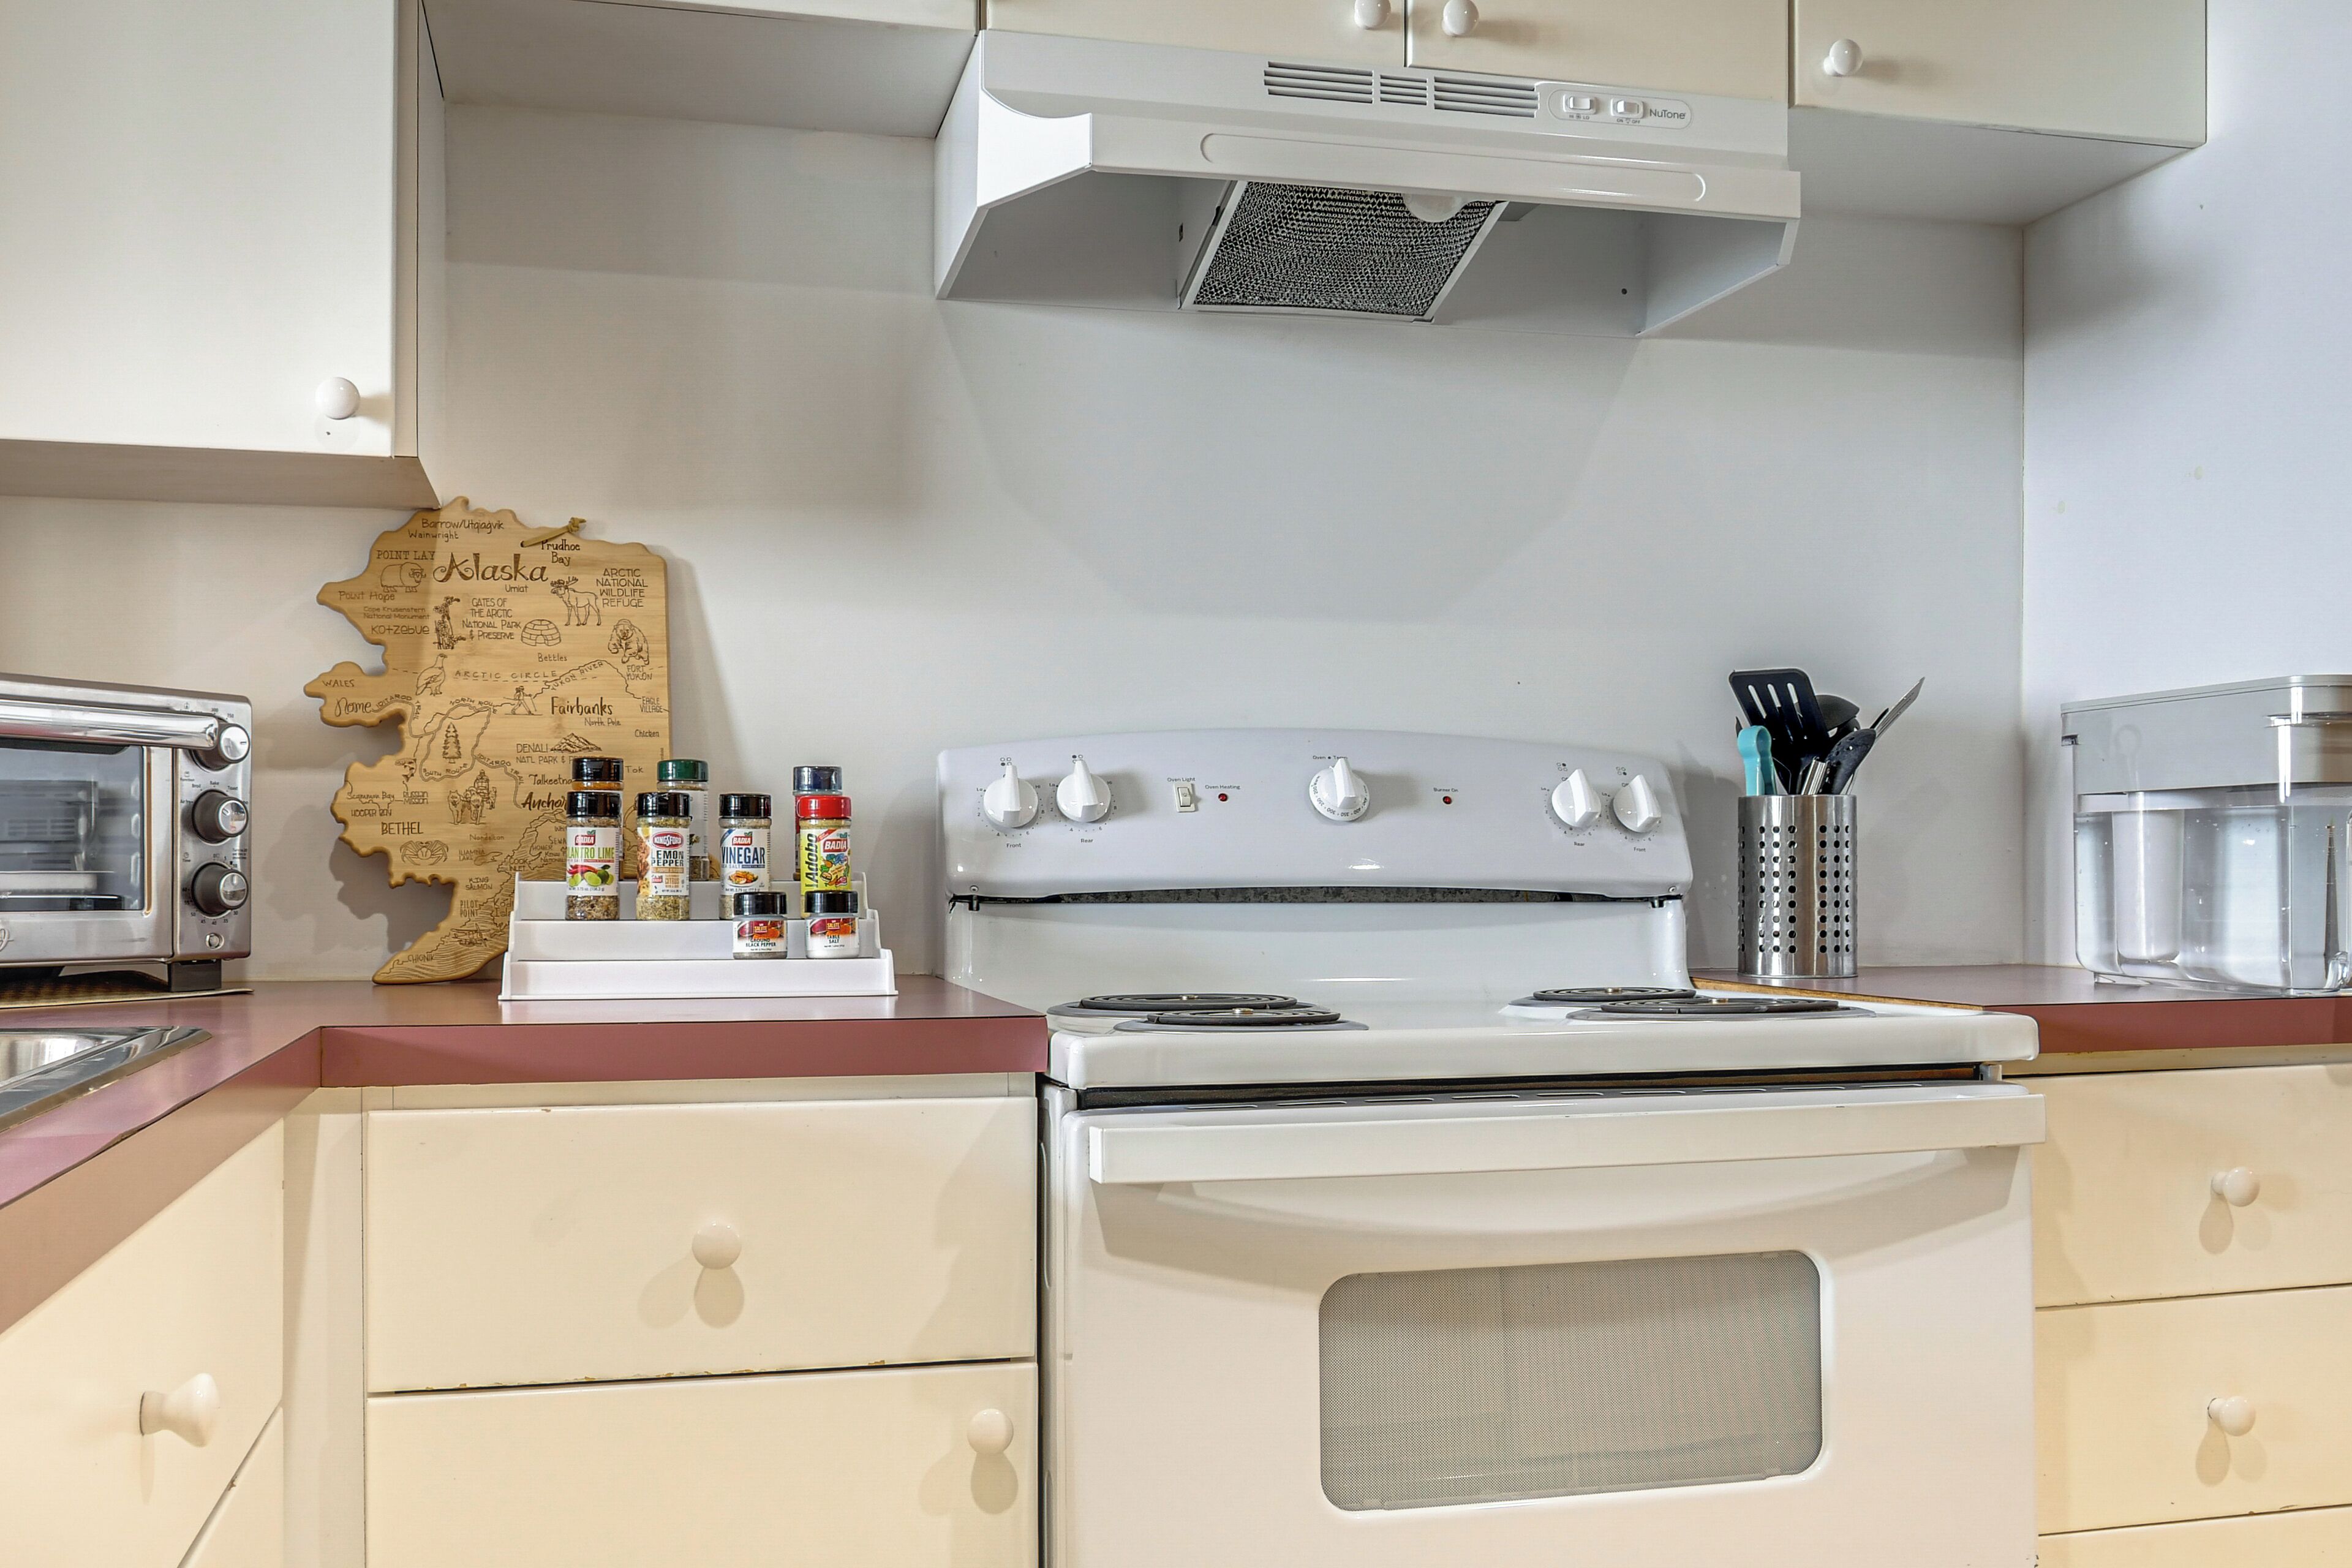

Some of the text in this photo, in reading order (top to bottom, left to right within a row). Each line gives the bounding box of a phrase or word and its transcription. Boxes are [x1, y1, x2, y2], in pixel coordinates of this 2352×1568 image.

[1649, 108, 1685, 119] NuTone
[408, 529, 459, 543] Wainwright
[541, 539, 581, 551] Prudhoe
[377, 551, 435, 560] POINT LAY
[551, 551, 571, 566] Bay
[433, 552, 548, 582] Alaska
[603, 568, 641, 577] ARCTIC
[596, 578, 648, 587] NATIONAL
[505, 584, 528, 593] Umiat
[599, 589, 645, 598] WILDLIFE
[370, 592, 395, 603] Hope
[472, 598, 507, 608] GATES OF
[602, 598, 644, 608] REFUGE
[470, 609, 513, 618] THE ARCTIC
[462, 619, 521, 629] NATIONAL PARK
[478, 630, 515, 640] PRESERVE
[538, 653, 568, 662] Bettles
[454, 671, 557, 679] ARCTIC CIRCLE
[551, 661, 603, 690] YUKON RIVER
[375, 694, 412, 708] IDITAROD
[449, 696, 475, 706] NORTH
[551, 696, 612, 716] Fairbanks
[334, 697, 372, 717] Nome
[516, 743, 548, 753] DENALI
[446, 763, 467, 774] ROUTE
[522, 792, 567, 810] Anchor
[382, 822, 424, 835] BETHEL
[549, 836, 567, 845] SEWA
[654, 835, 682, 846] KINGSFORD
[825, 841, 846, 850] BADIA
[598, 847, 614, 859] LIME
[652, 850, 684, 859] LEMON
[722, 847, 765, 864] VINEGAR
[805, 833, 818, 883] Adobo
[460, 900, 478, 908] PILOT
[493, 897, 514, 907] Kodi
